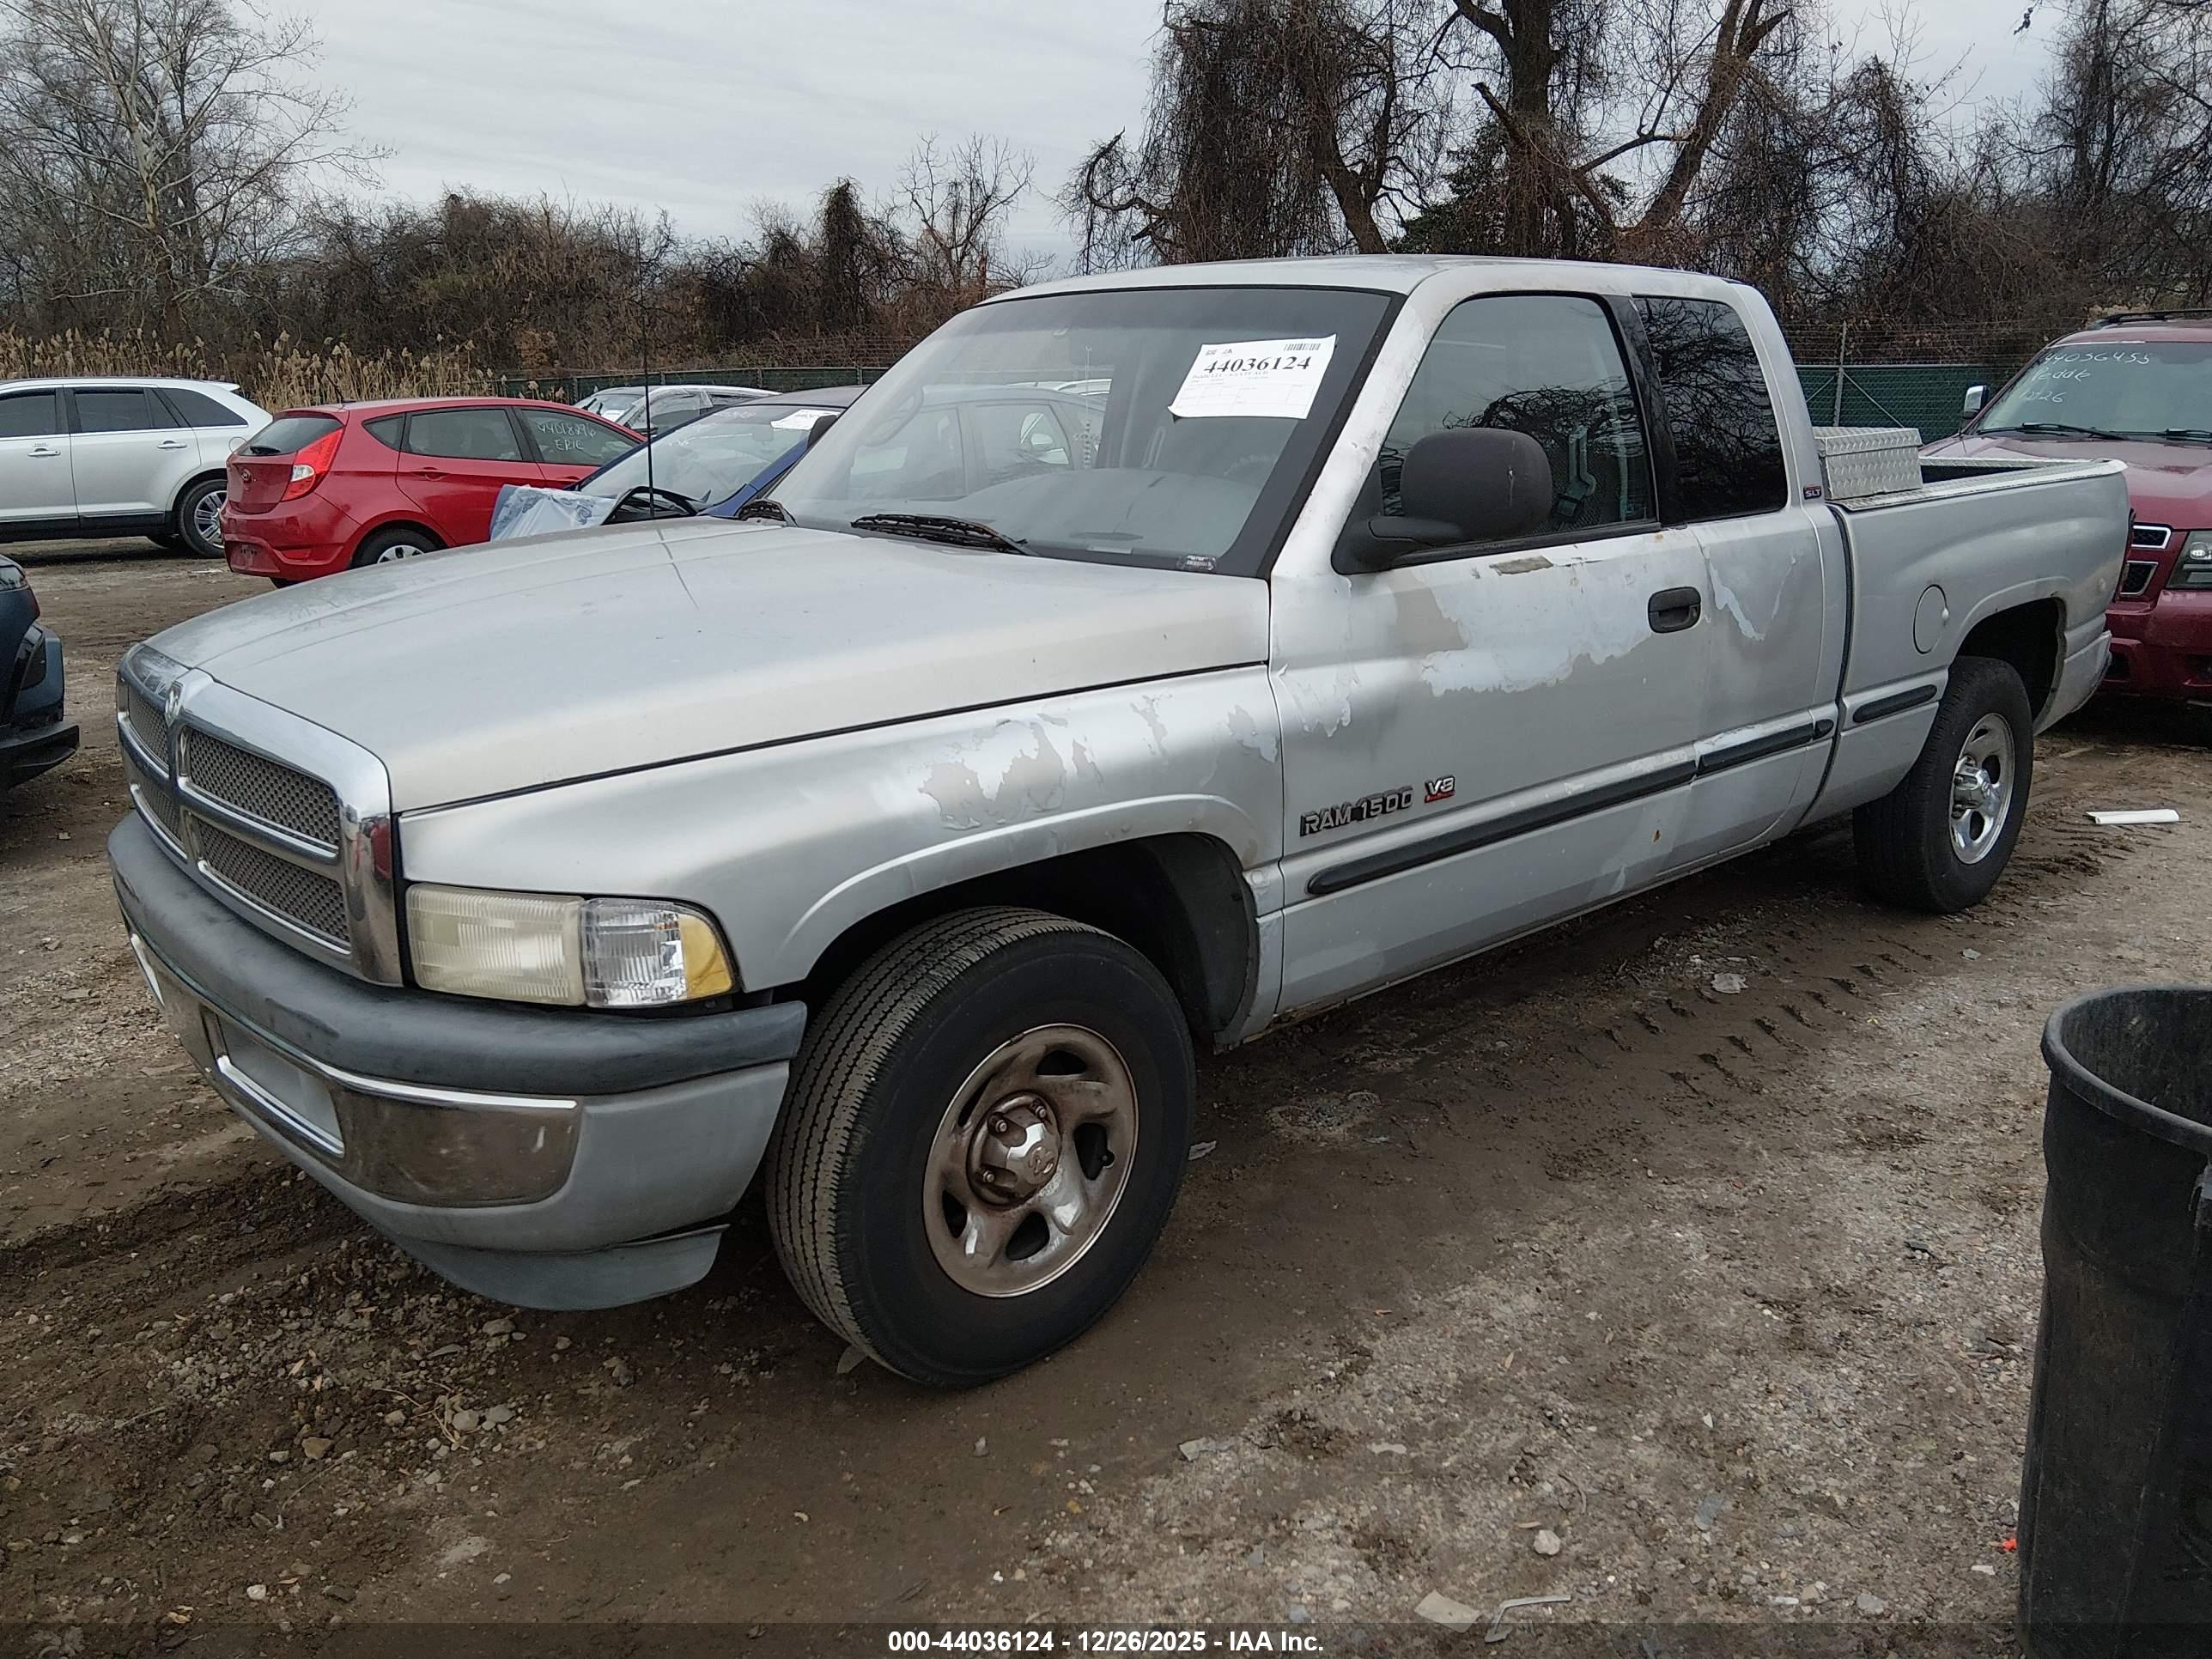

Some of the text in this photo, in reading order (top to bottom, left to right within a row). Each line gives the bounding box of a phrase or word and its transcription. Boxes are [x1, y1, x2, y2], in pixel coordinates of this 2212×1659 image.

[1204, 356, 1312, 374] 44036124
[555, 439, 585, 452] ERIC
[1805, 489, 1820, 498] SLT
[1301, 805, 1352, 835] RAM
[1359, 789, 1413, 818] 1500
[1425, 776, 1455, 796] V8
